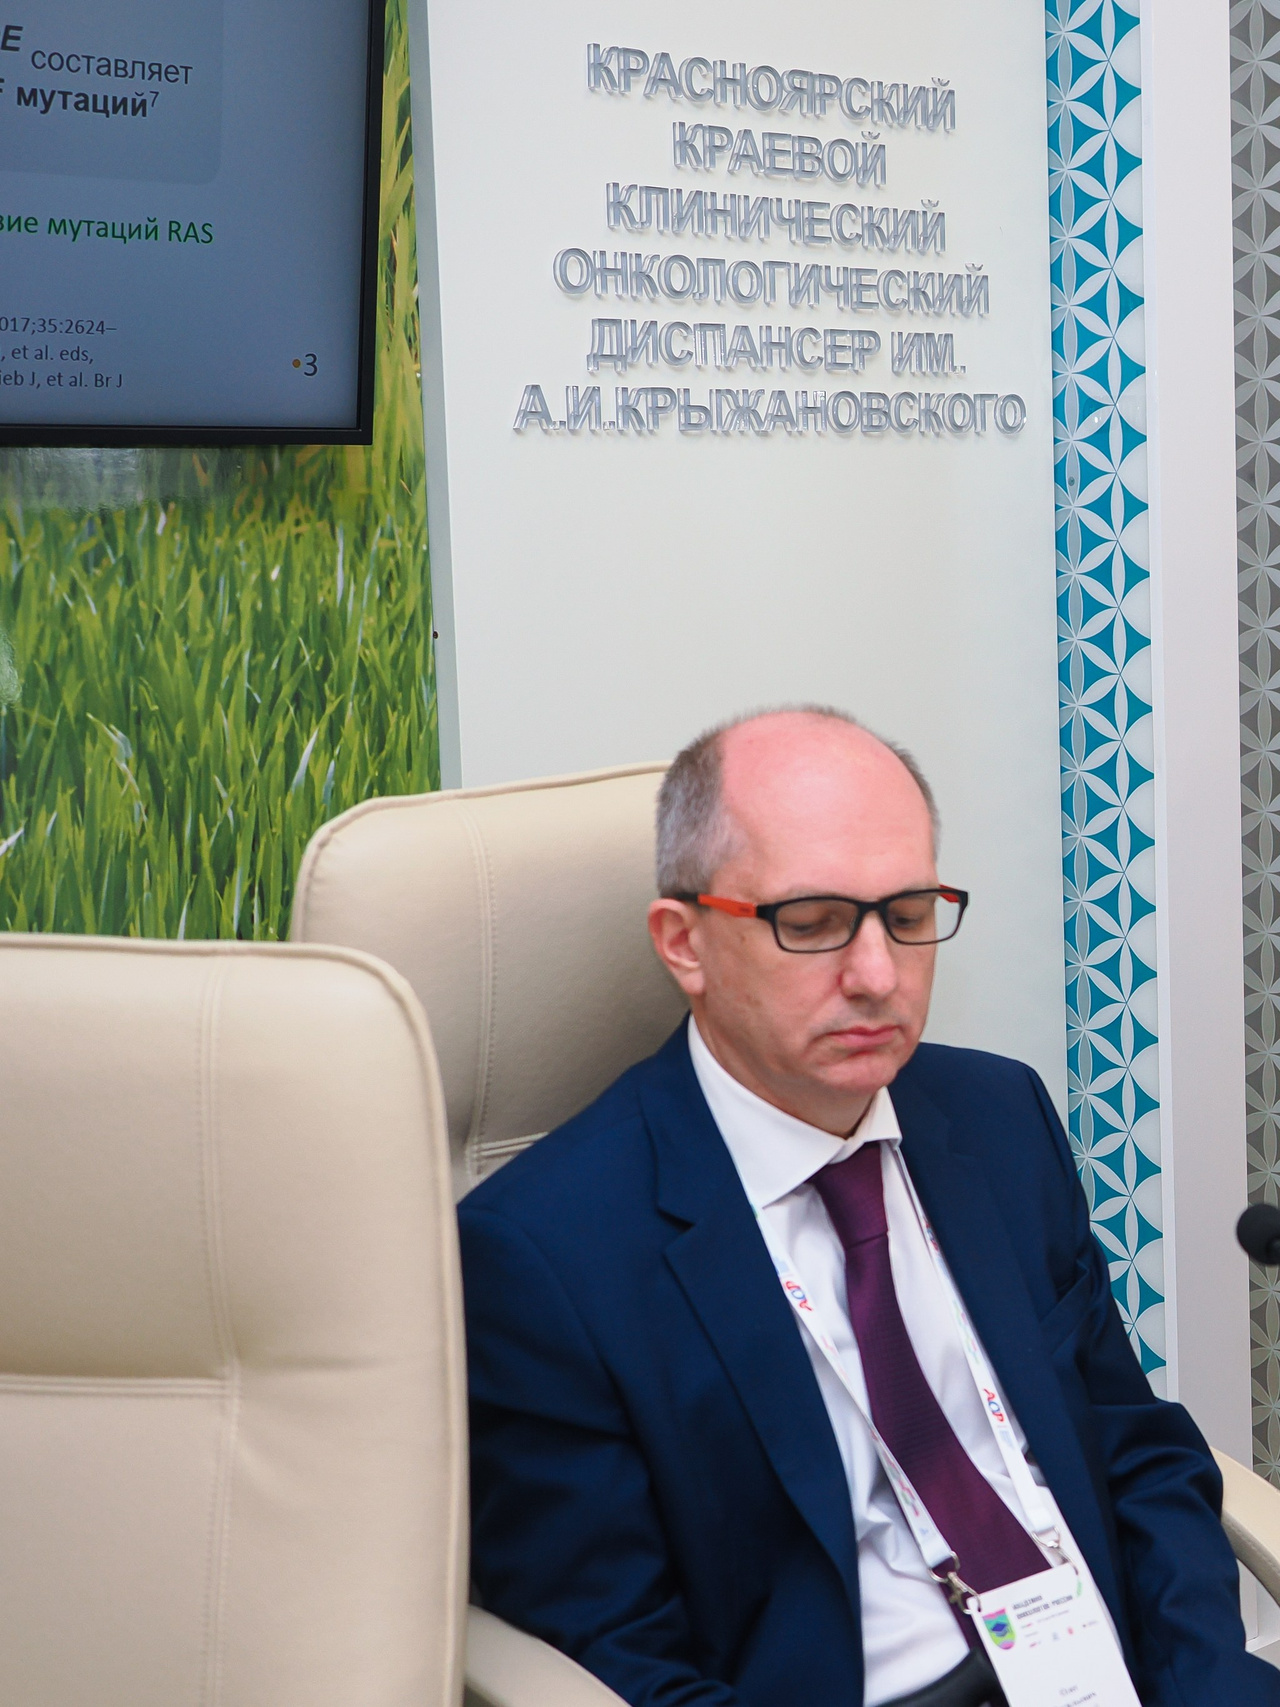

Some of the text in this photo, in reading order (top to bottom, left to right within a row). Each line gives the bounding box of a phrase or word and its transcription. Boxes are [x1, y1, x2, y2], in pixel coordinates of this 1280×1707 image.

[31, 49, 193, 85] составляет
[585, 42, 956, 131] КРАСНОЯРСКИЙ
[672, 121, 887, 186] КРАЕВОЙ
[47, 217, 159, 244] мутаций
[168, 221, 214, 244] RAS
[606, 182, 946, 252] КЛИНИЧЕСКИЙ
[552, 247, 990, 315] ОНКОЛОГИЧЕСКИЙ
[11, 345, 29, 360] et
[34, 345, 54, 361] al.
[59, 346, 94, 365] eds,
[586, 317, 966, 375] ДИСПАНСЕР ИМ.
[29, 371, 41, 389] J,
[46, 372, 64, 387] et
[69, 372, 88, 387] al.
[94, 373, 112, 388] Br
[116, 374, 123, 388] J
[512, 384, 1027, 435] А.И.КРЫЖАНОВСКОГО
